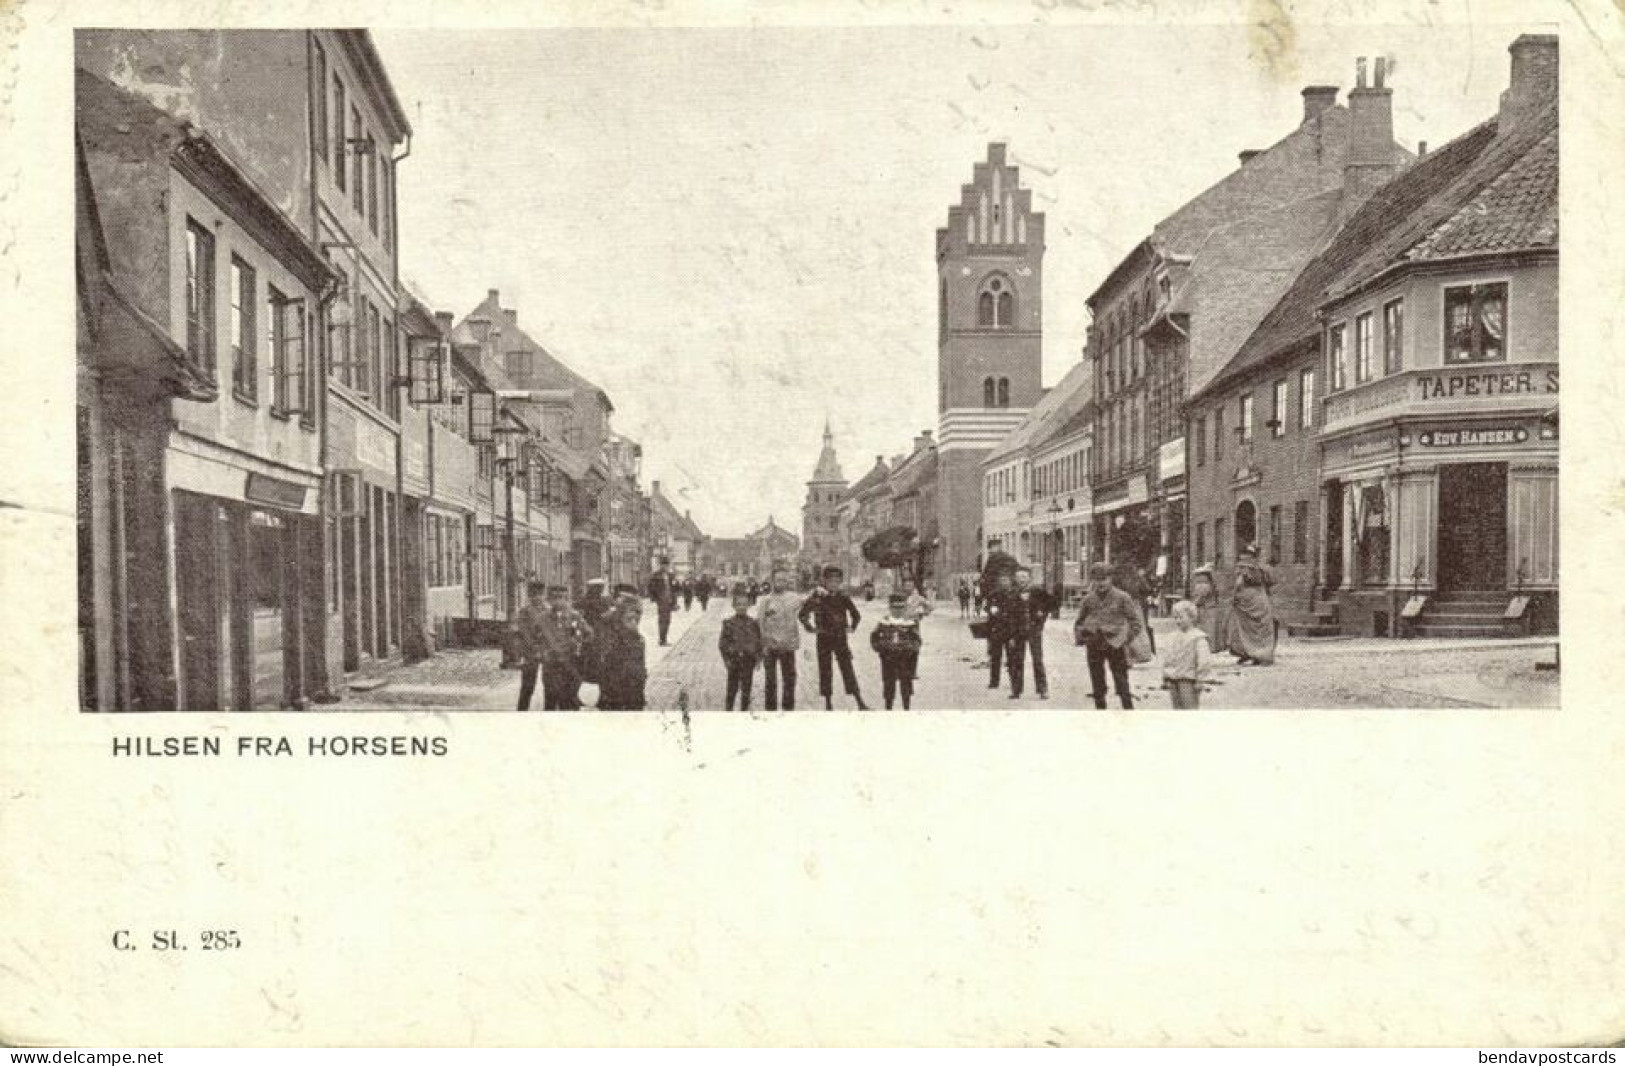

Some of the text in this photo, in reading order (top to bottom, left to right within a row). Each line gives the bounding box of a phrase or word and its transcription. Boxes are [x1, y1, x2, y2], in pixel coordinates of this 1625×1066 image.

[1416, 371, 1537, 400] TAPETER.
[113, 736, 447, 756] HILSEN FRA HORSENS
[113, 931, 135, 950] C.
[202, 931, 240, 950] 285
